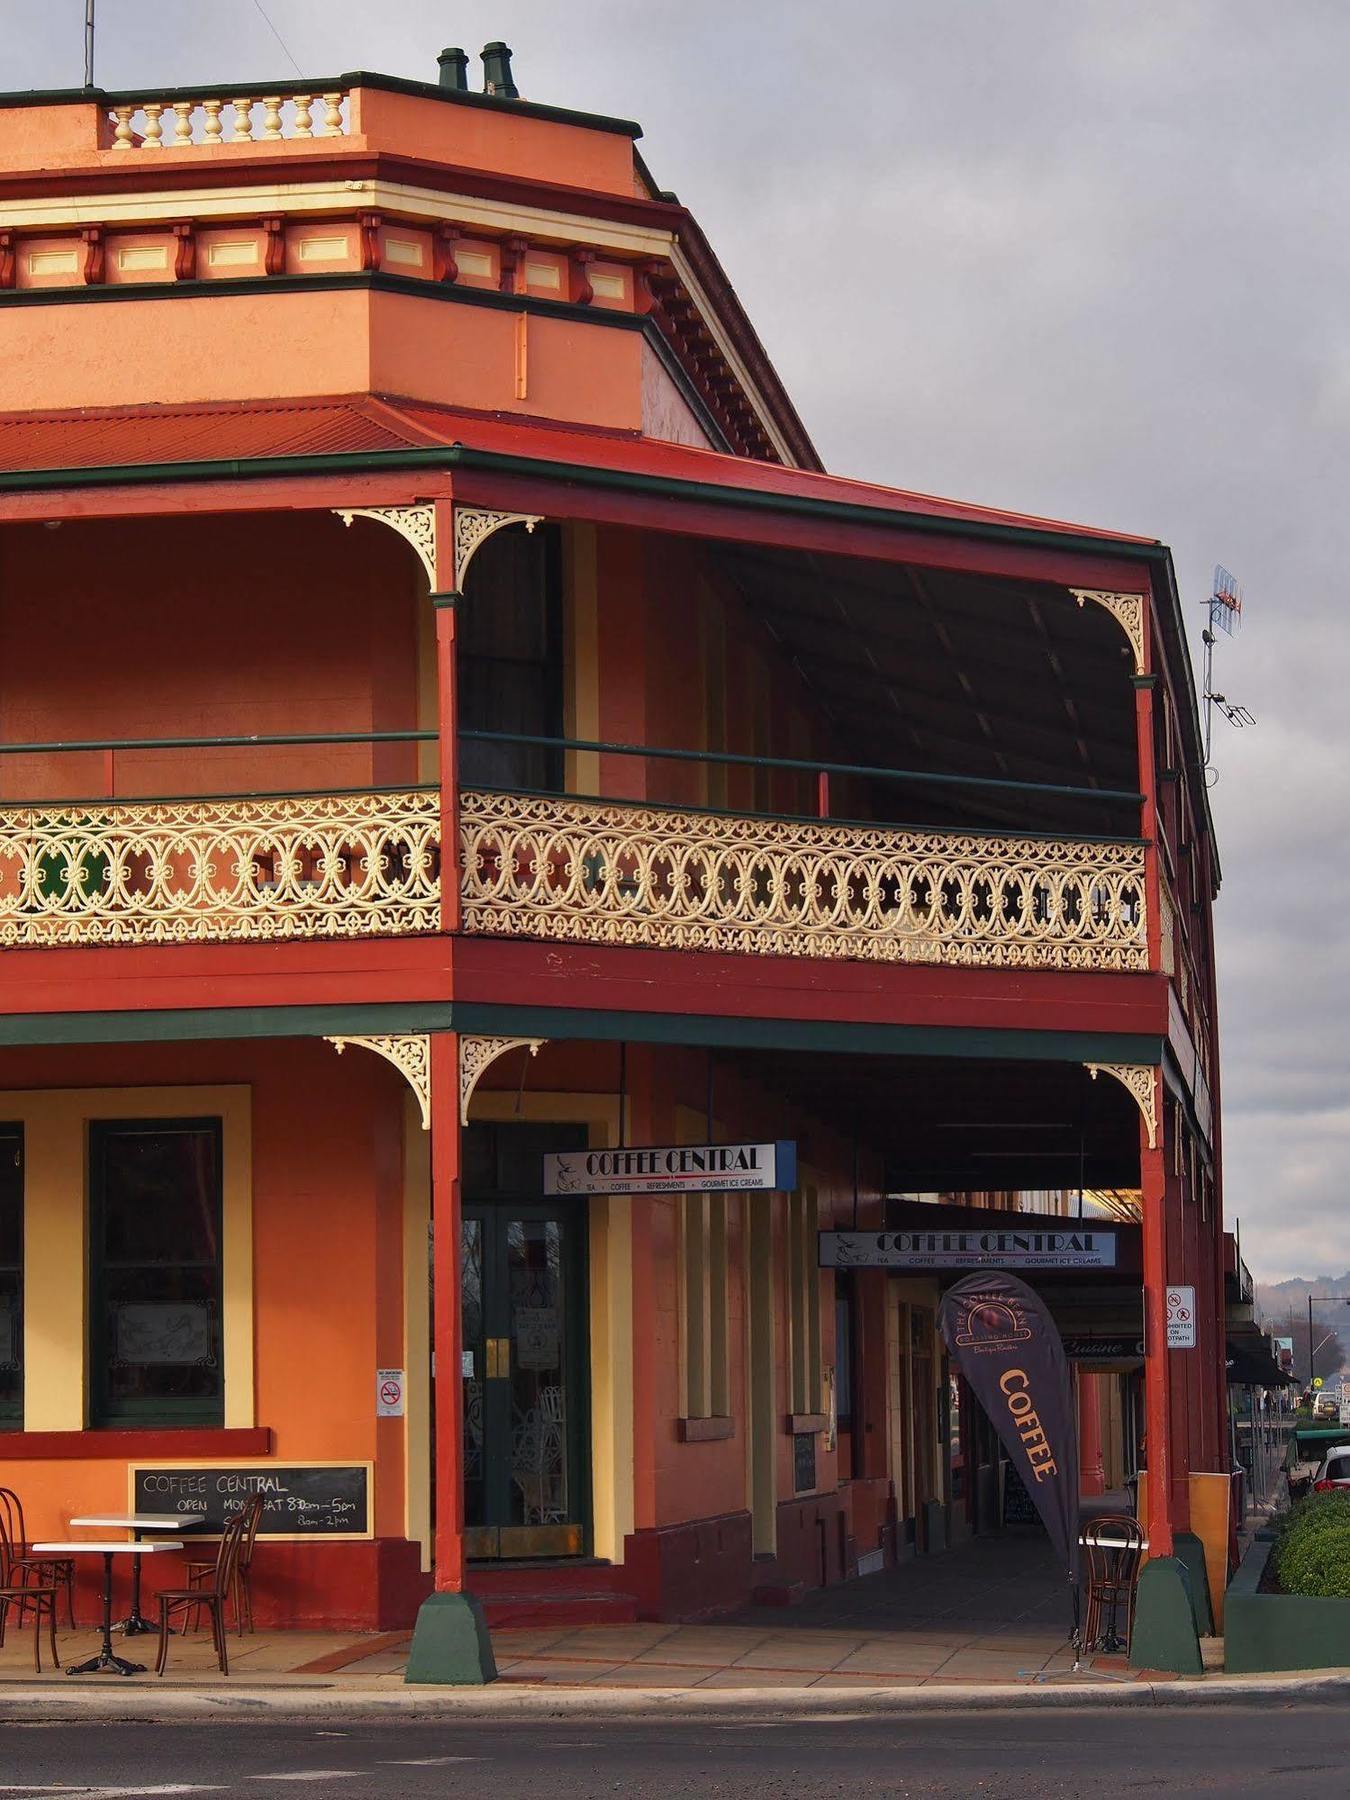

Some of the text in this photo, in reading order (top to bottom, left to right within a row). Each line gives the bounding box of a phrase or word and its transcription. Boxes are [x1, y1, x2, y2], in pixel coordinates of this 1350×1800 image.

[586, 1147, 762, 1176] COFFEE CENTRAL
[586, 1178, 764, 1191] TEA COFFEE REFRESHMENTS GOURMET ICE CREAMS
[877, 1233, 1100, 1252] COFFEE CENTRAL
[999, 1368, 1060, 1483] COFFEE
[143, 1474, 289, 1493] COFFEE CENTRAL
[177, 1499, 208, 1512] OPEN
